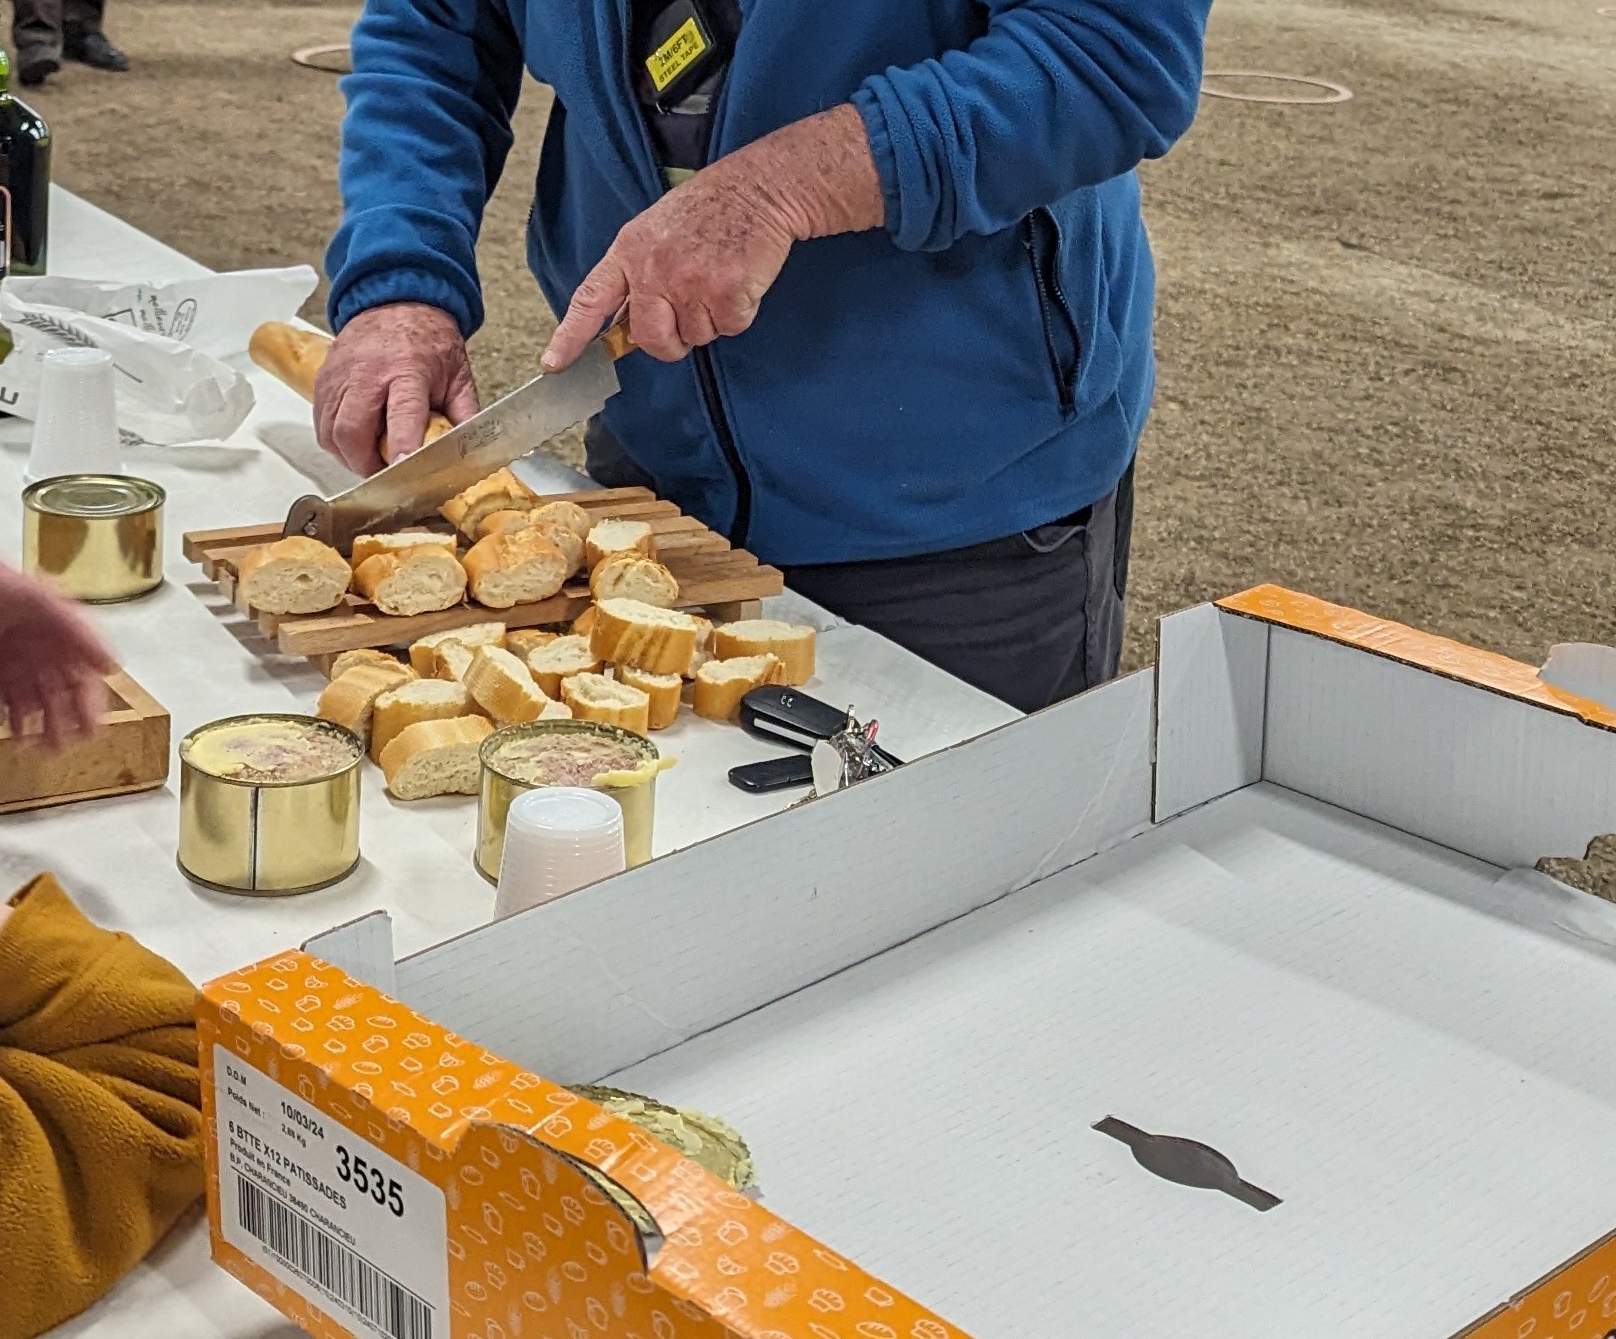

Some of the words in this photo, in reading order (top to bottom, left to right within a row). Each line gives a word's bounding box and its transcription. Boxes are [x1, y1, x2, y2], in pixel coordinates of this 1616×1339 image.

[659, 60, 681, 83] STEEL
[680, 42, 699, 61] TAPE
[281, 1101, 324, 1139] 10/03/24
[230, 1137, 255, 1162] Produit
[256, 1157, 266, 1168] en
[266, 1163, 291, 1187] France
[236, 1124, 261, 1152] BTTE
[263, 1144, 282, 1166] X12
[284, 1157, 347, 1210] PATISSADES
[336, 1145, 404, 1217] 3535
